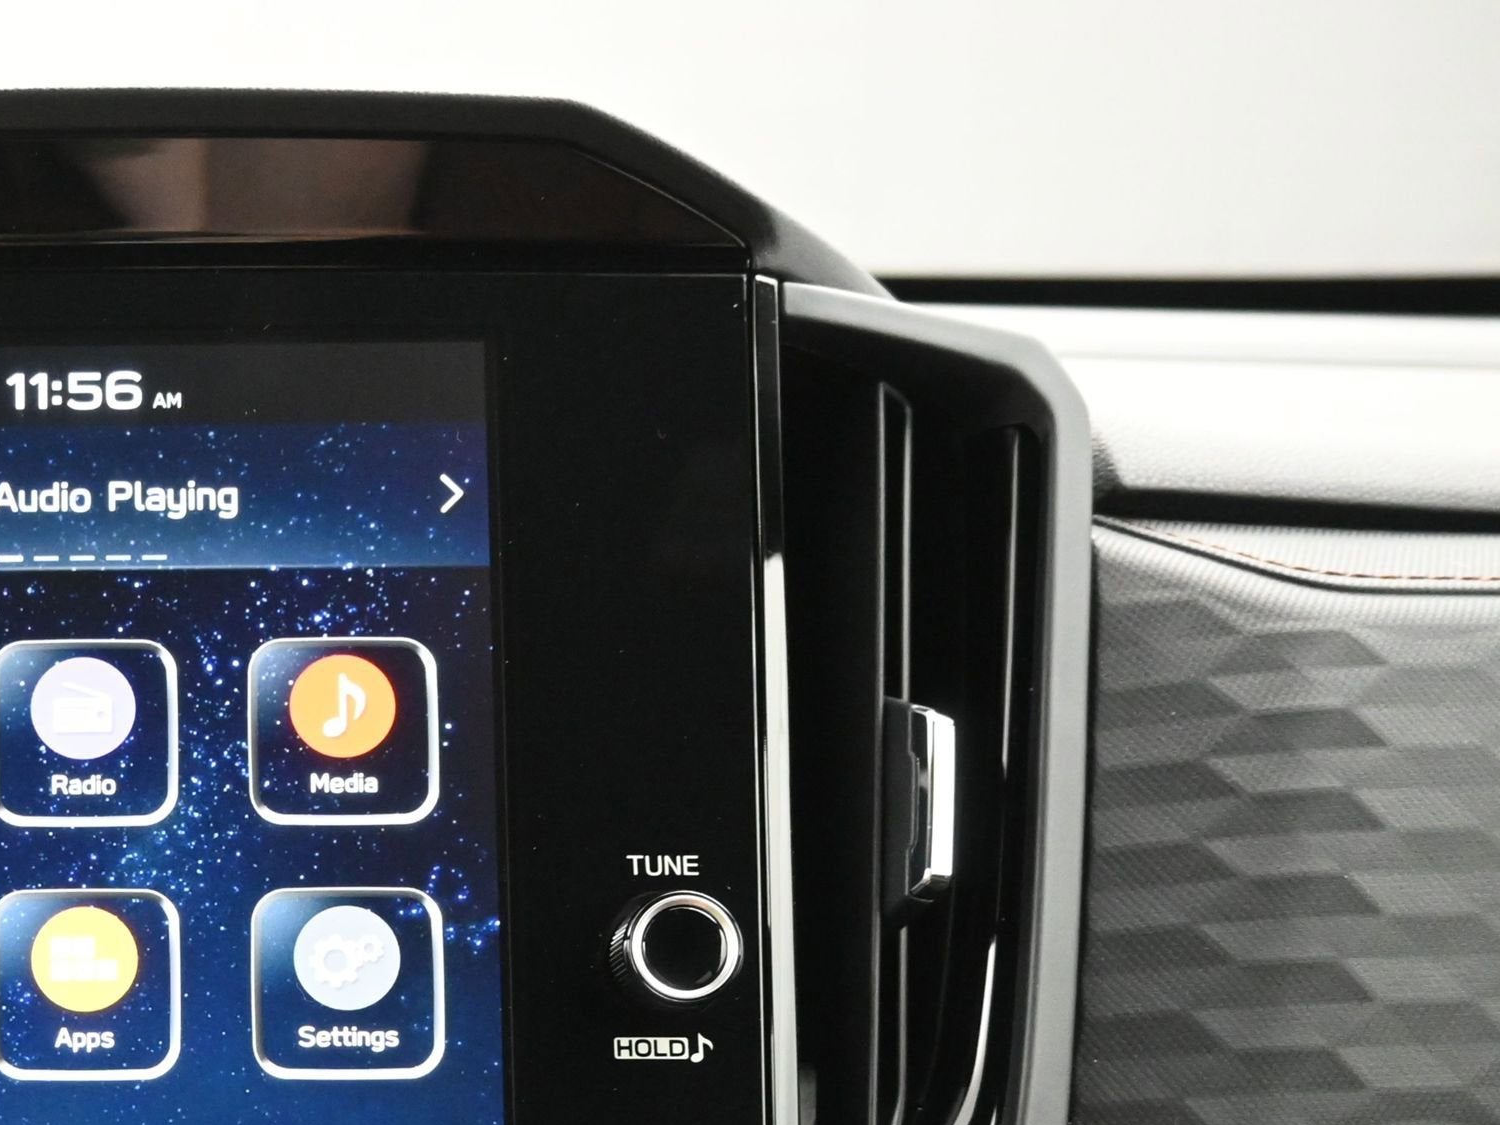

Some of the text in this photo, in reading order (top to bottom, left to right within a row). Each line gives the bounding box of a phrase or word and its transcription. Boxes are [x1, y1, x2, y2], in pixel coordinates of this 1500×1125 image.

[5, 370, 183, 412] 11:56 AM
[108, 478, 239, 520] Playing
[50, 773, 117, 796] Radio
[309, 772, 379, 795] Media
[626, 855, 699, 876] TUNE
[54, 1027, 115, 1052] Apps
[297, 1025, 400, 1053] Settings
[616, 1039, 687, 1058] HOLD
